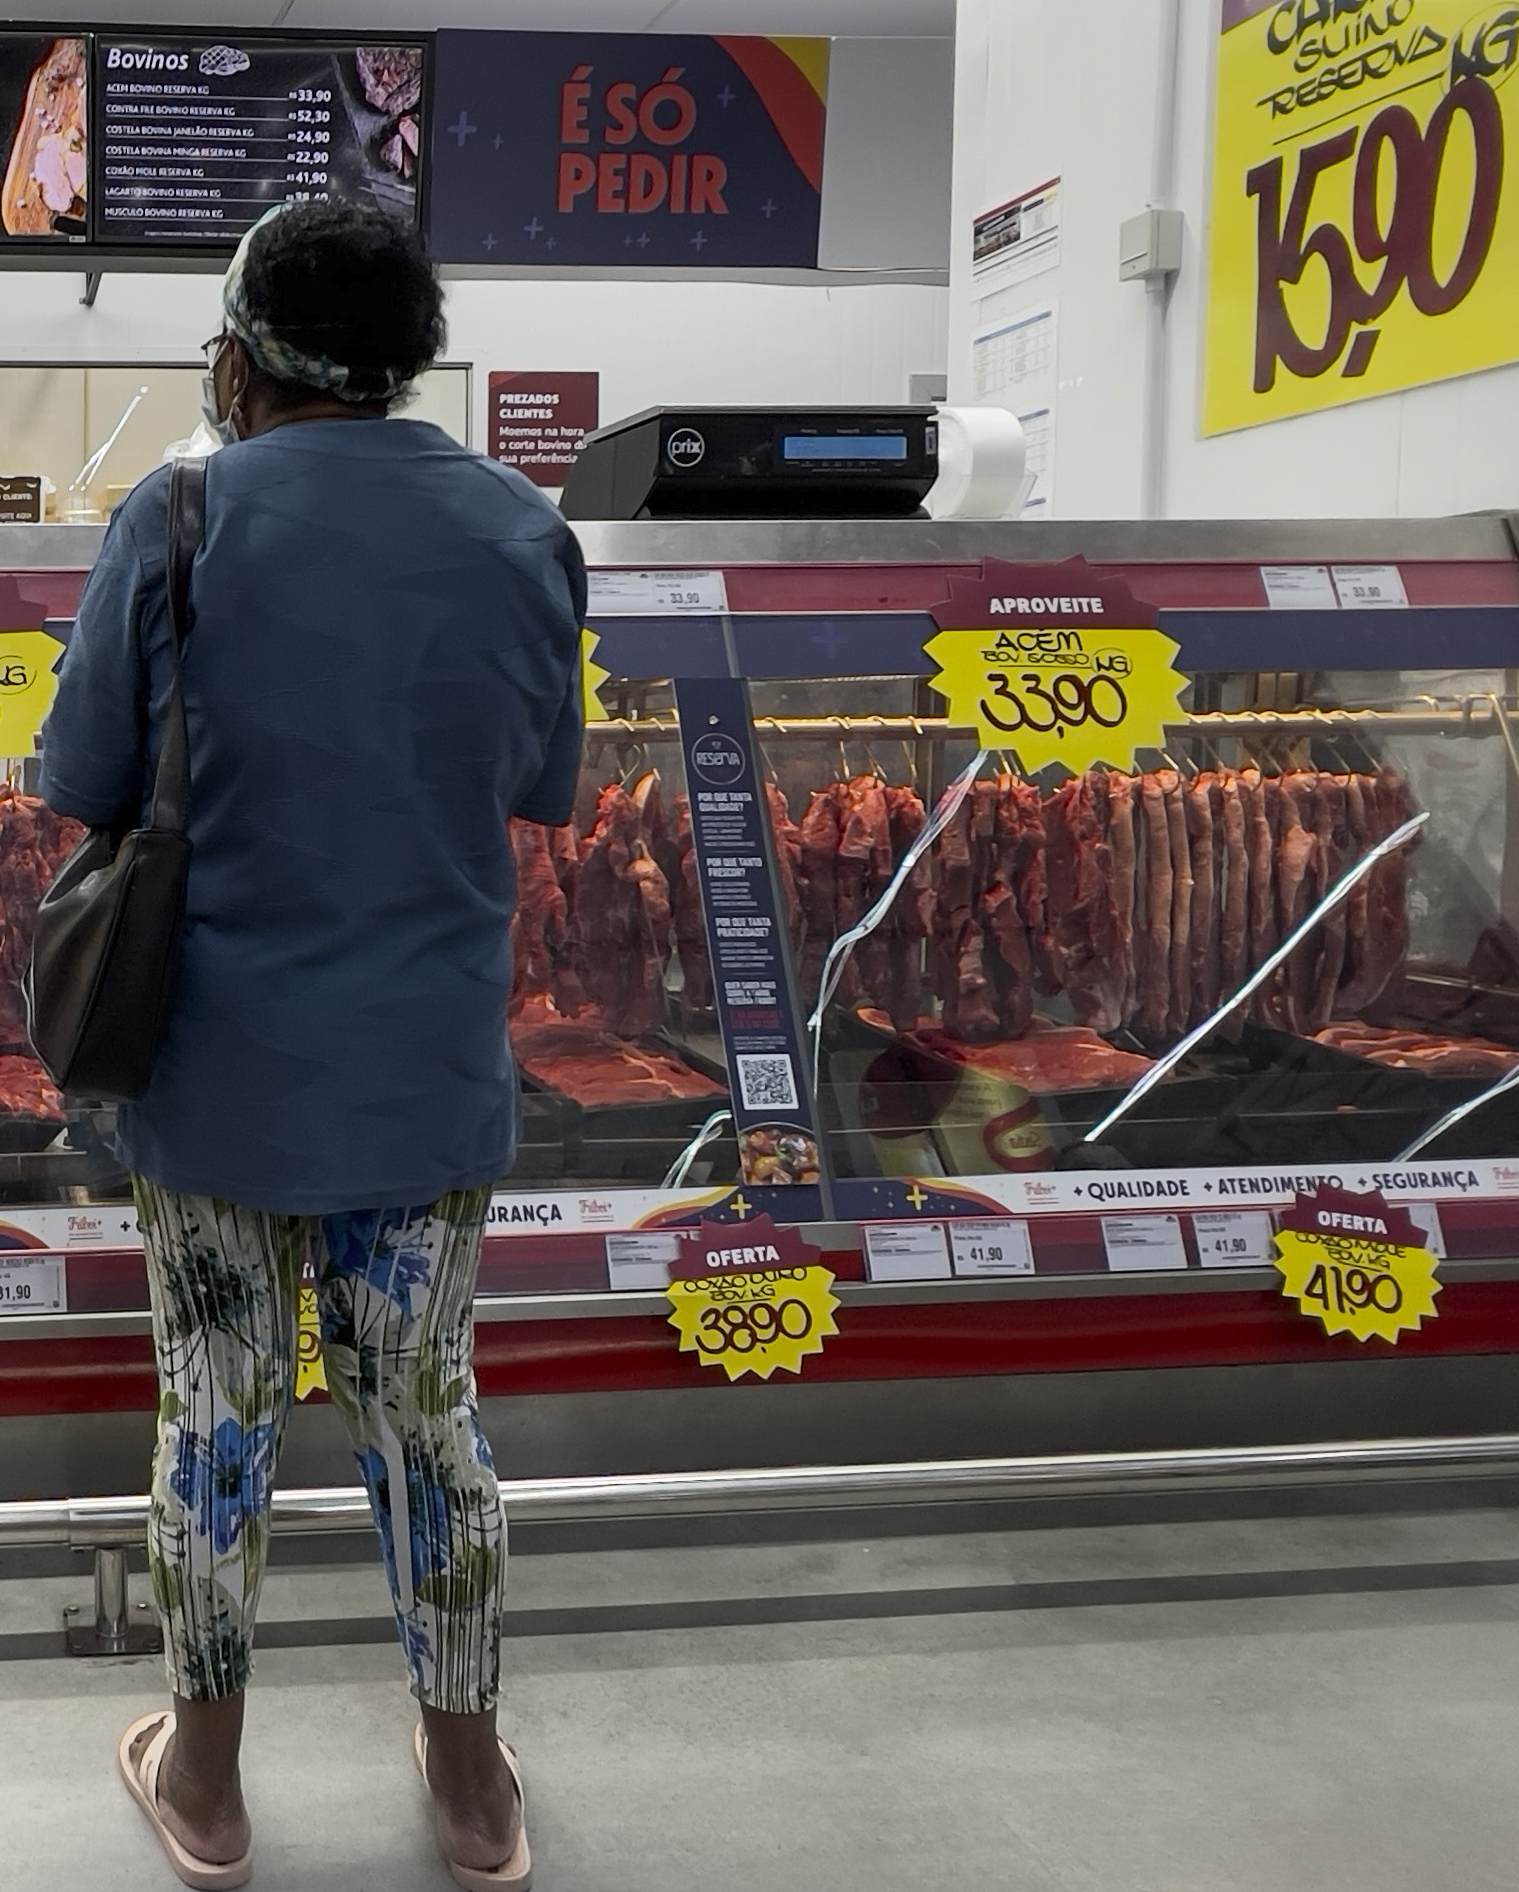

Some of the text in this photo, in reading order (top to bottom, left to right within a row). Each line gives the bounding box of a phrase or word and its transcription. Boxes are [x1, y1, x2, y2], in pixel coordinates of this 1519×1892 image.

[107, 48, 189, 70] Bovinos
[1256, 25, 1447, 120] RESERVA
[298, 90, 331, 102] 33,90
[559, 65, 697, 146] É SÓ
[298, 111, 330, 123] 52,30
[296, 132, 330, 144] 24,90
[296, 153, 329, 165] 22,90
[295, 173, 327, 185] 41,90
[558, 152, 729, 215] PEDIR
[1246, 75, 1504, 394] 15,90
[499, 394, 559, 404] PREZADOS
[499, 408, 553, 419] CLIENTES
[499, 426, 541, 436] Moemos
[545, 428, 558, 436] na
[671, 437, 701, 459] prix
[990, 597, 1104, 614] APROVEITE
[981, 674, 1127, 739] 33,90
[1088, 1179, 1190, 1202] QUALIDADE
[1372, 1171, 1479, 1192] SEGURANÇA
[487, 1204, 562, 1226] URANÇA
[1317, 1211, 1388, 1234] OFERTA
[706, 1245, 780, 1267] OFERTA
[970, 1246, 1003, 1262] 41,90
[1215, 1238, 1246, 1252] 41,90
[695, 1299, 812, 1354] 38,90
